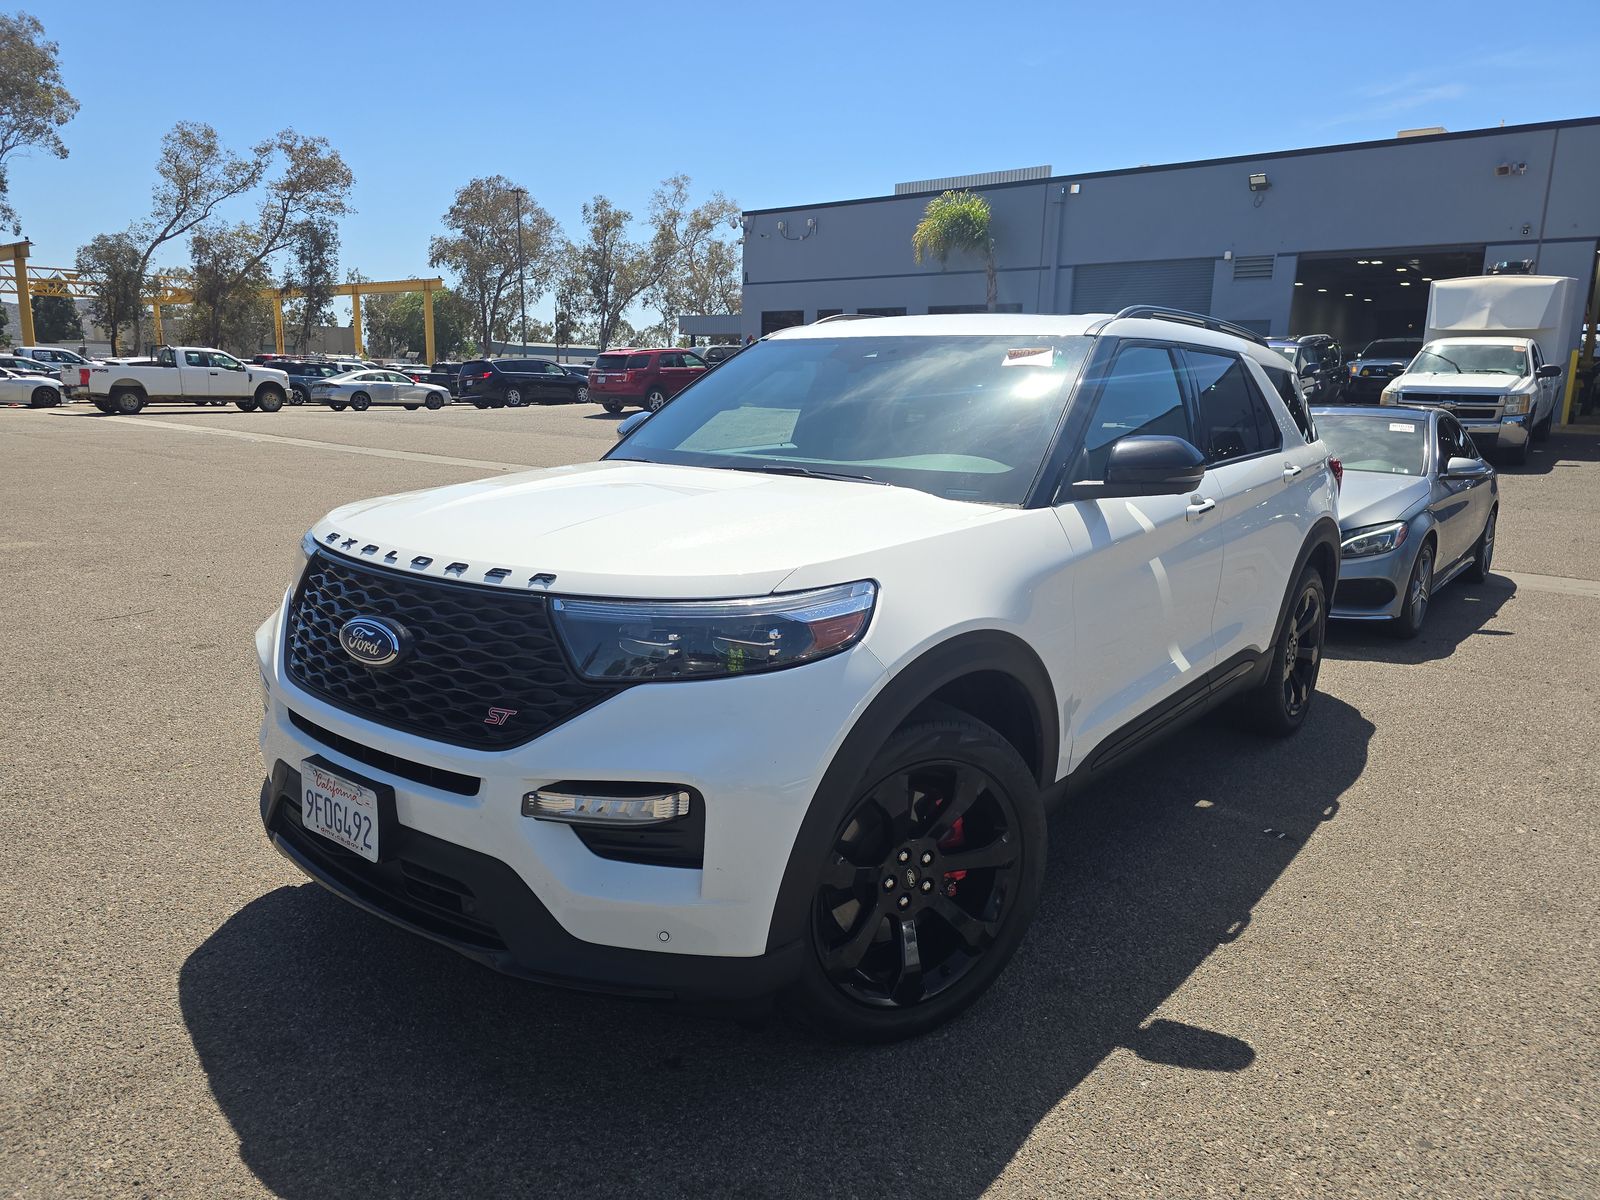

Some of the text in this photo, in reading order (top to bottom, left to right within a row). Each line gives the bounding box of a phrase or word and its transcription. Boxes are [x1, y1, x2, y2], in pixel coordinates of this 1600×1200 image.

[326, 532, 558, 587] EXPLORER
[348, 626, 382, 656] Ford
[484, 707, 517, 725] ST
